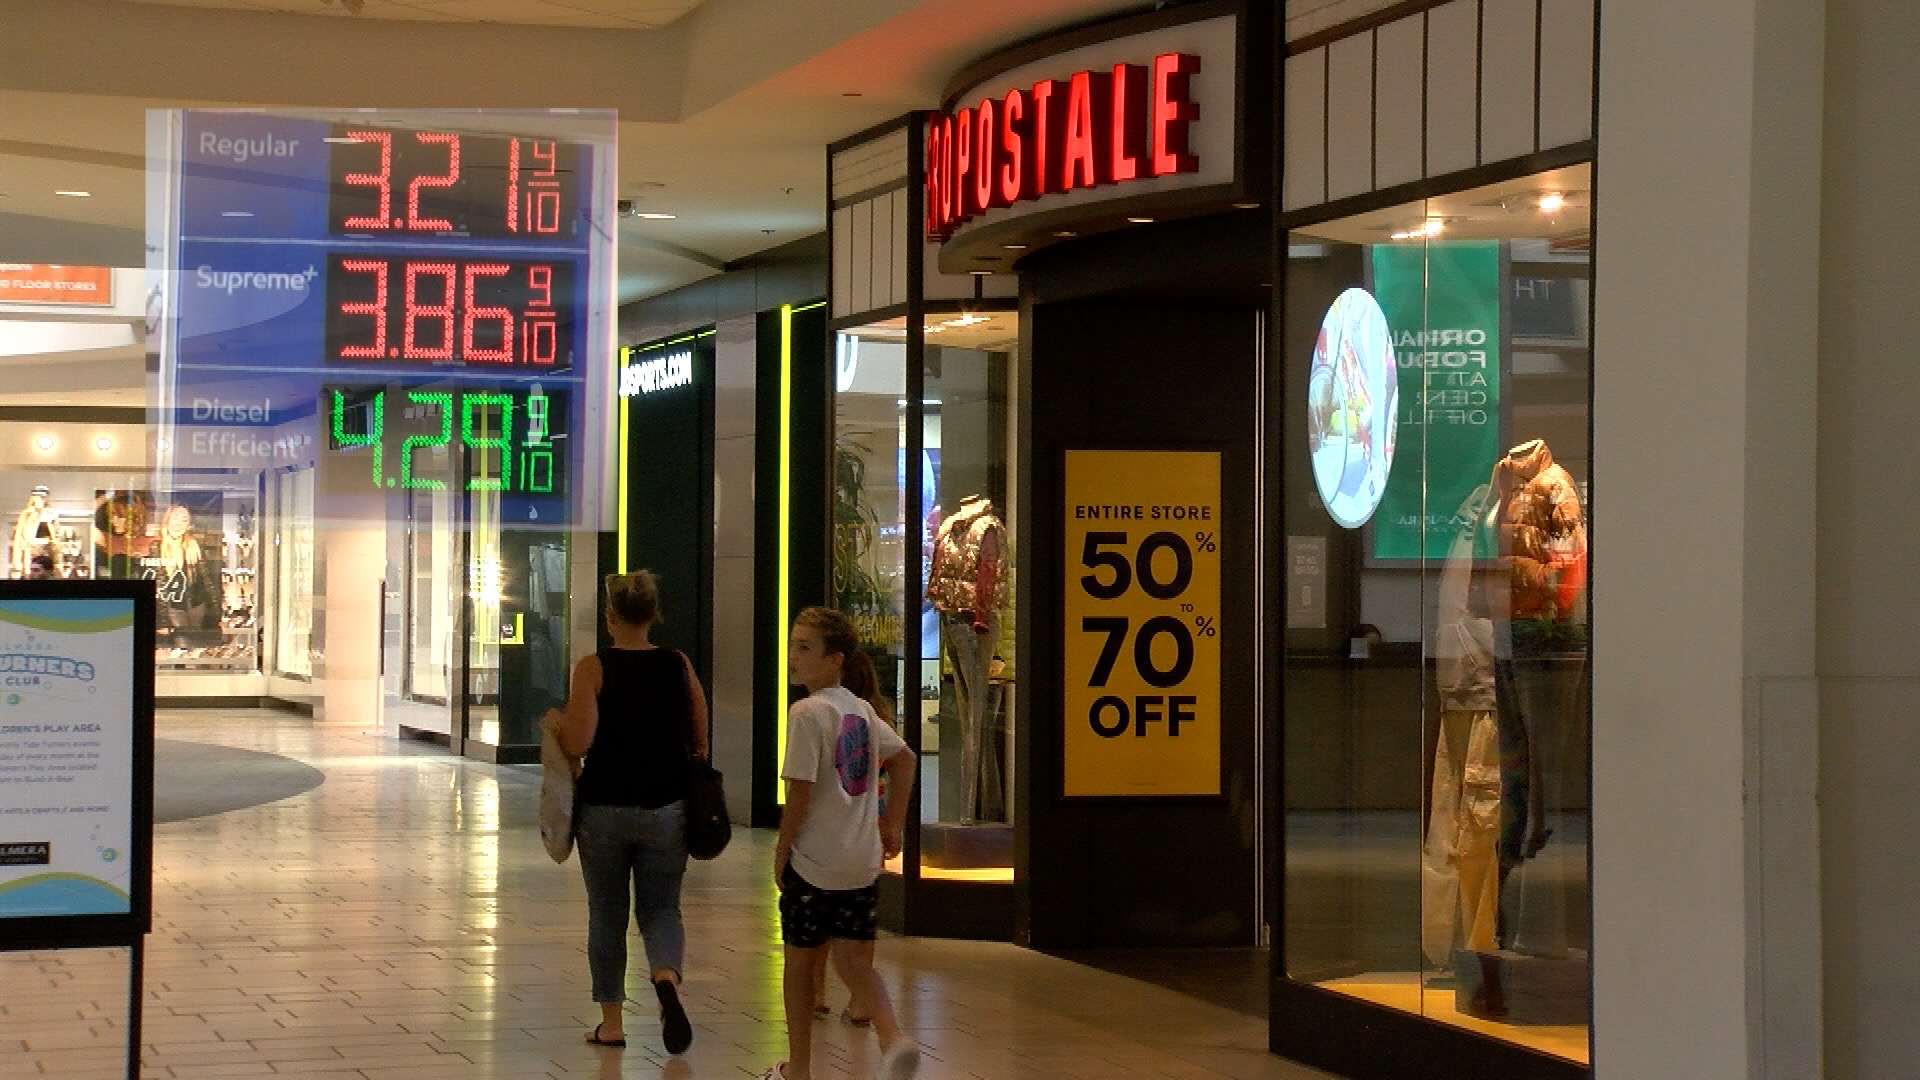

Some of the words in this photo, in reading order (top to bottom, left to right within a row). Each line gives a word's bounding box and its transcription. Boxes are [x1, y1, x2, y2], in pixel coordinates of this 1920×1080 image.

[200, 132, 300, 162] Regular
[344, 131, 520, 233] 3.21
[340, 259, 514, 364] 3.86
[191, 431, 299, 459] Efficient
[192, 397, 270, 423] Diesel
[333, 388, 514, 491] 4.29
[1075, 505, 1144, 519] ENTIRE
[1151, 505, 1211, 520] STORE
[1180, 603, 1194, 612] TO
[5, 676, 40, 686] CLUB
[72, 723, 101, 732] AREA
[1088, 695, 1197, 738] OFF
